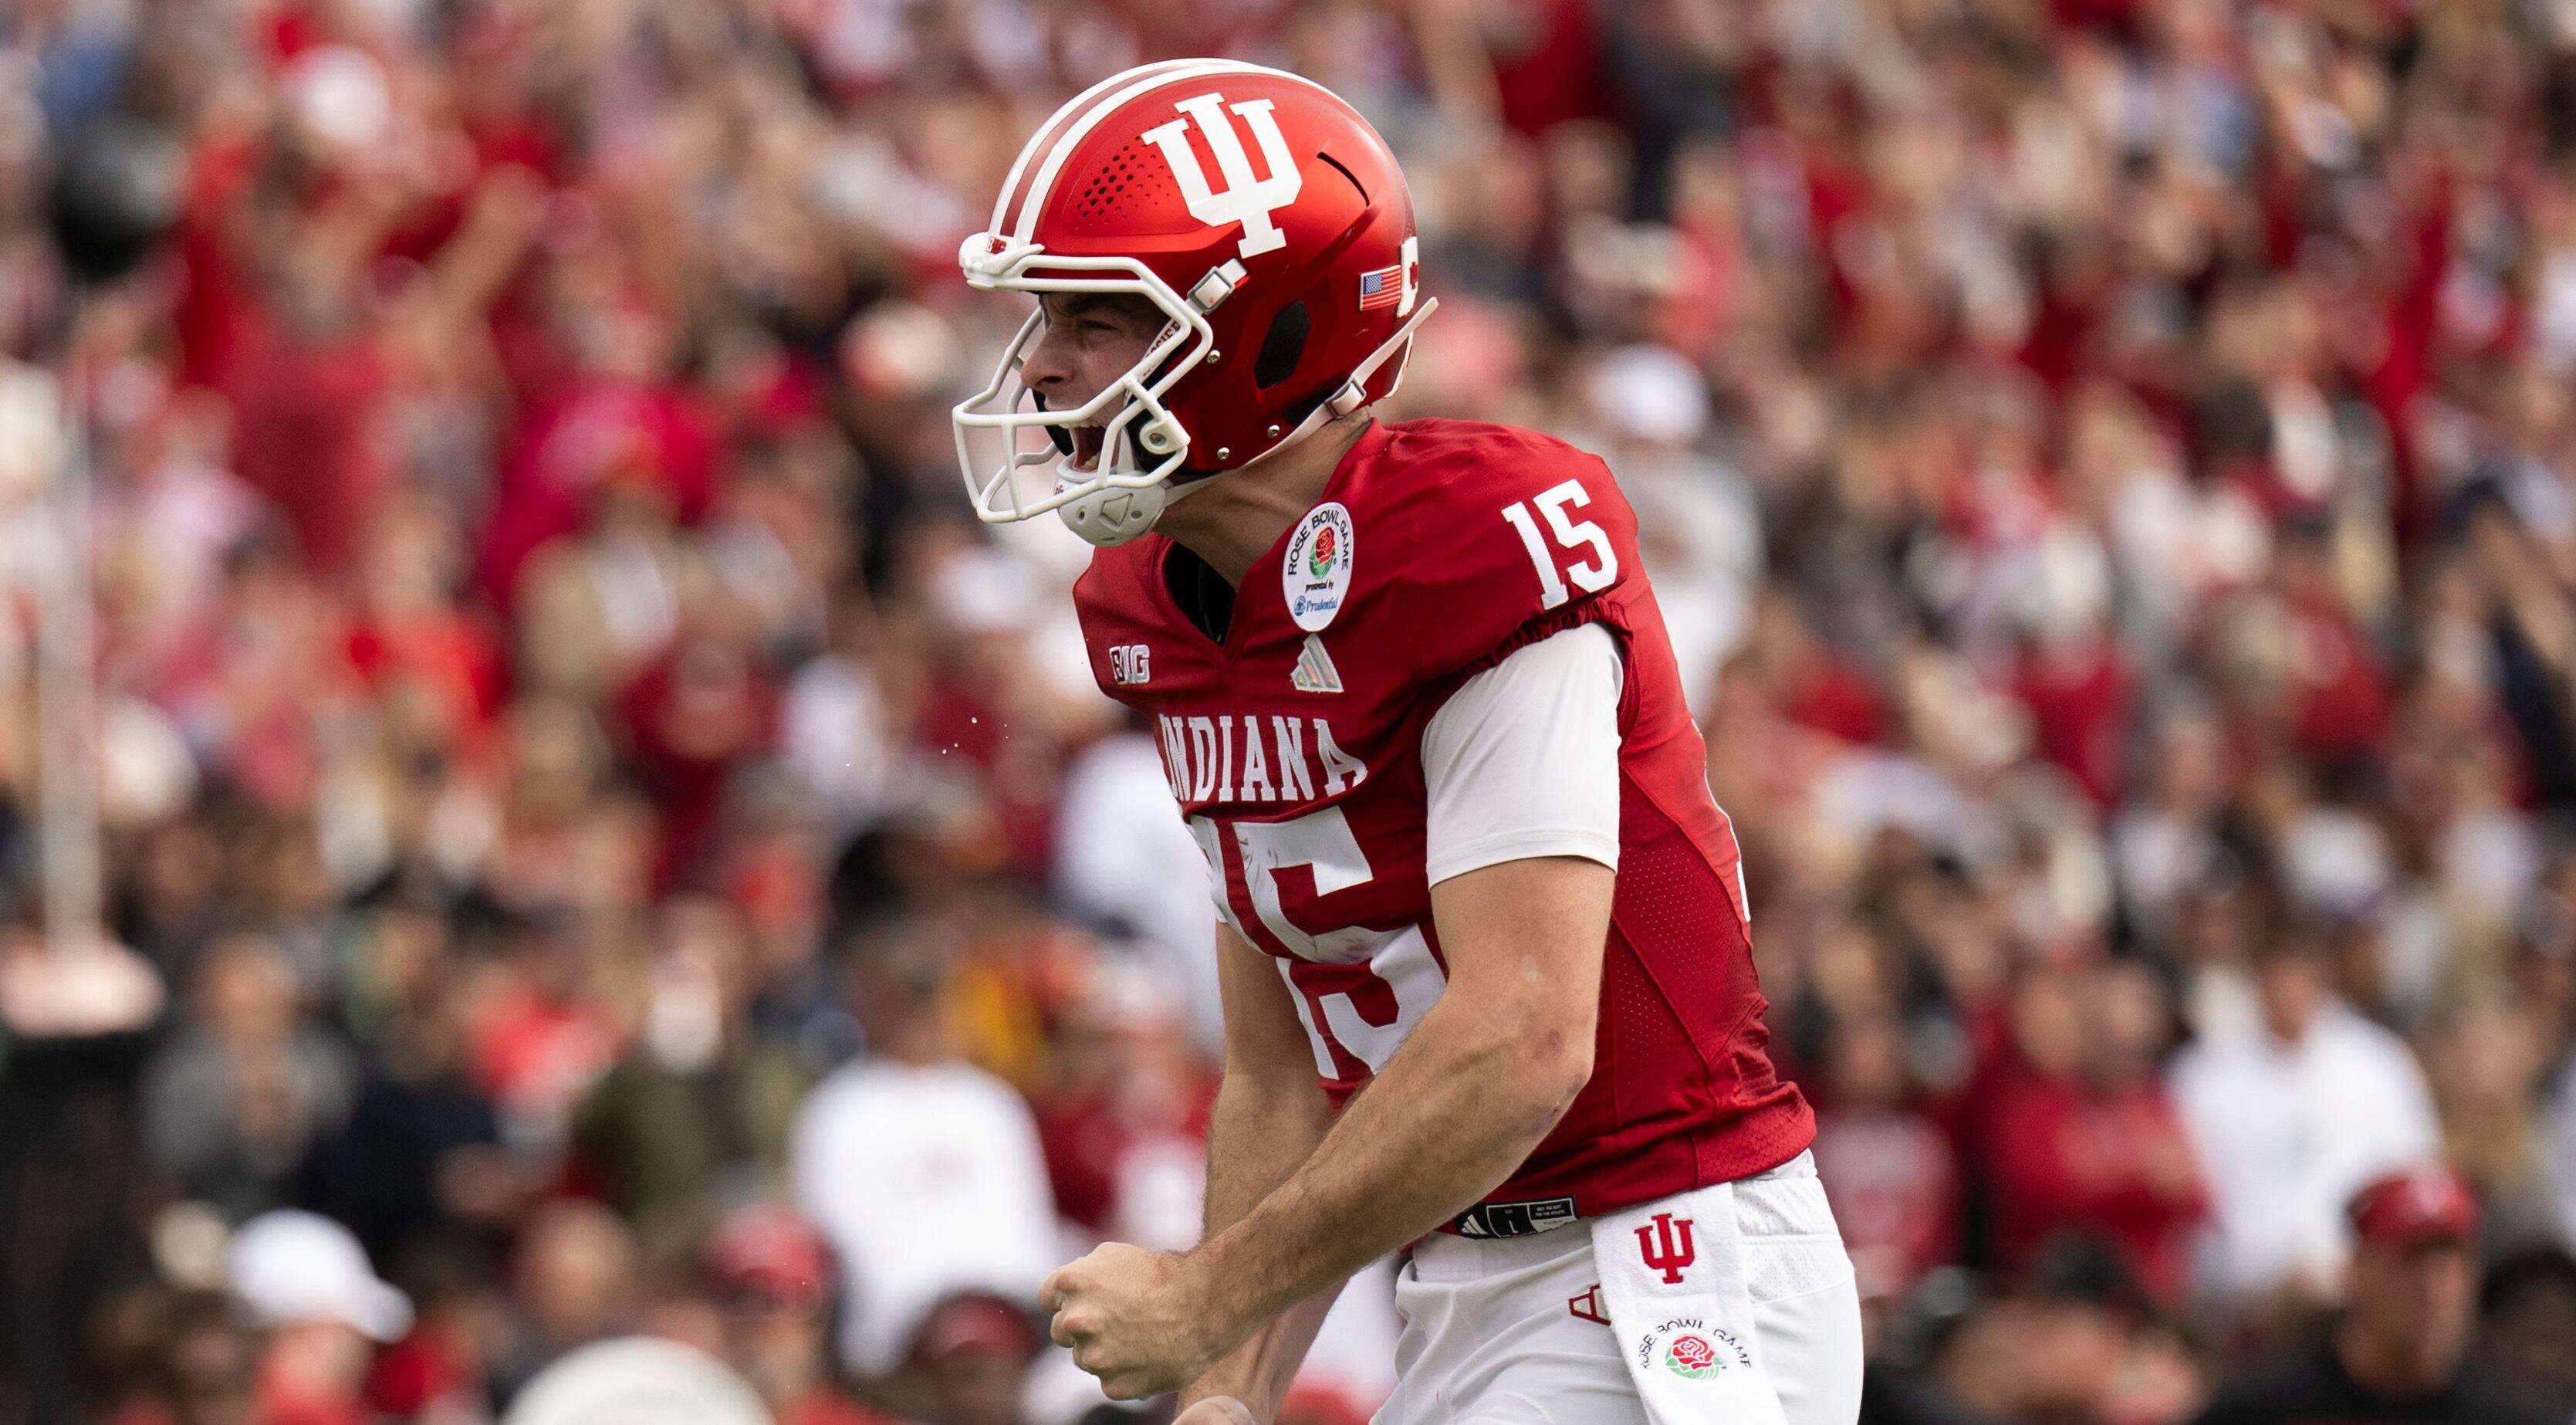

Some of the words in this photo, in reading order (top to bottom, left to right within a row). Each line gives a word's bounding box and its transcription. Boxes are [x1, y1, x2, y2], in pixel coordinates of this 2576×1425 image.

[1288, 526, 1310, 575] ROSE
[1312, 510, 1339, 530] BOWL
[1340, 519, 1350, 571] GAME
[1501, 478, 1618, 610] 15
[1306, 597, 1339, 612] Prudential
[1158, 712, 1368, 803] INDIANA
[1183, 804, 1448, 1081] 15
